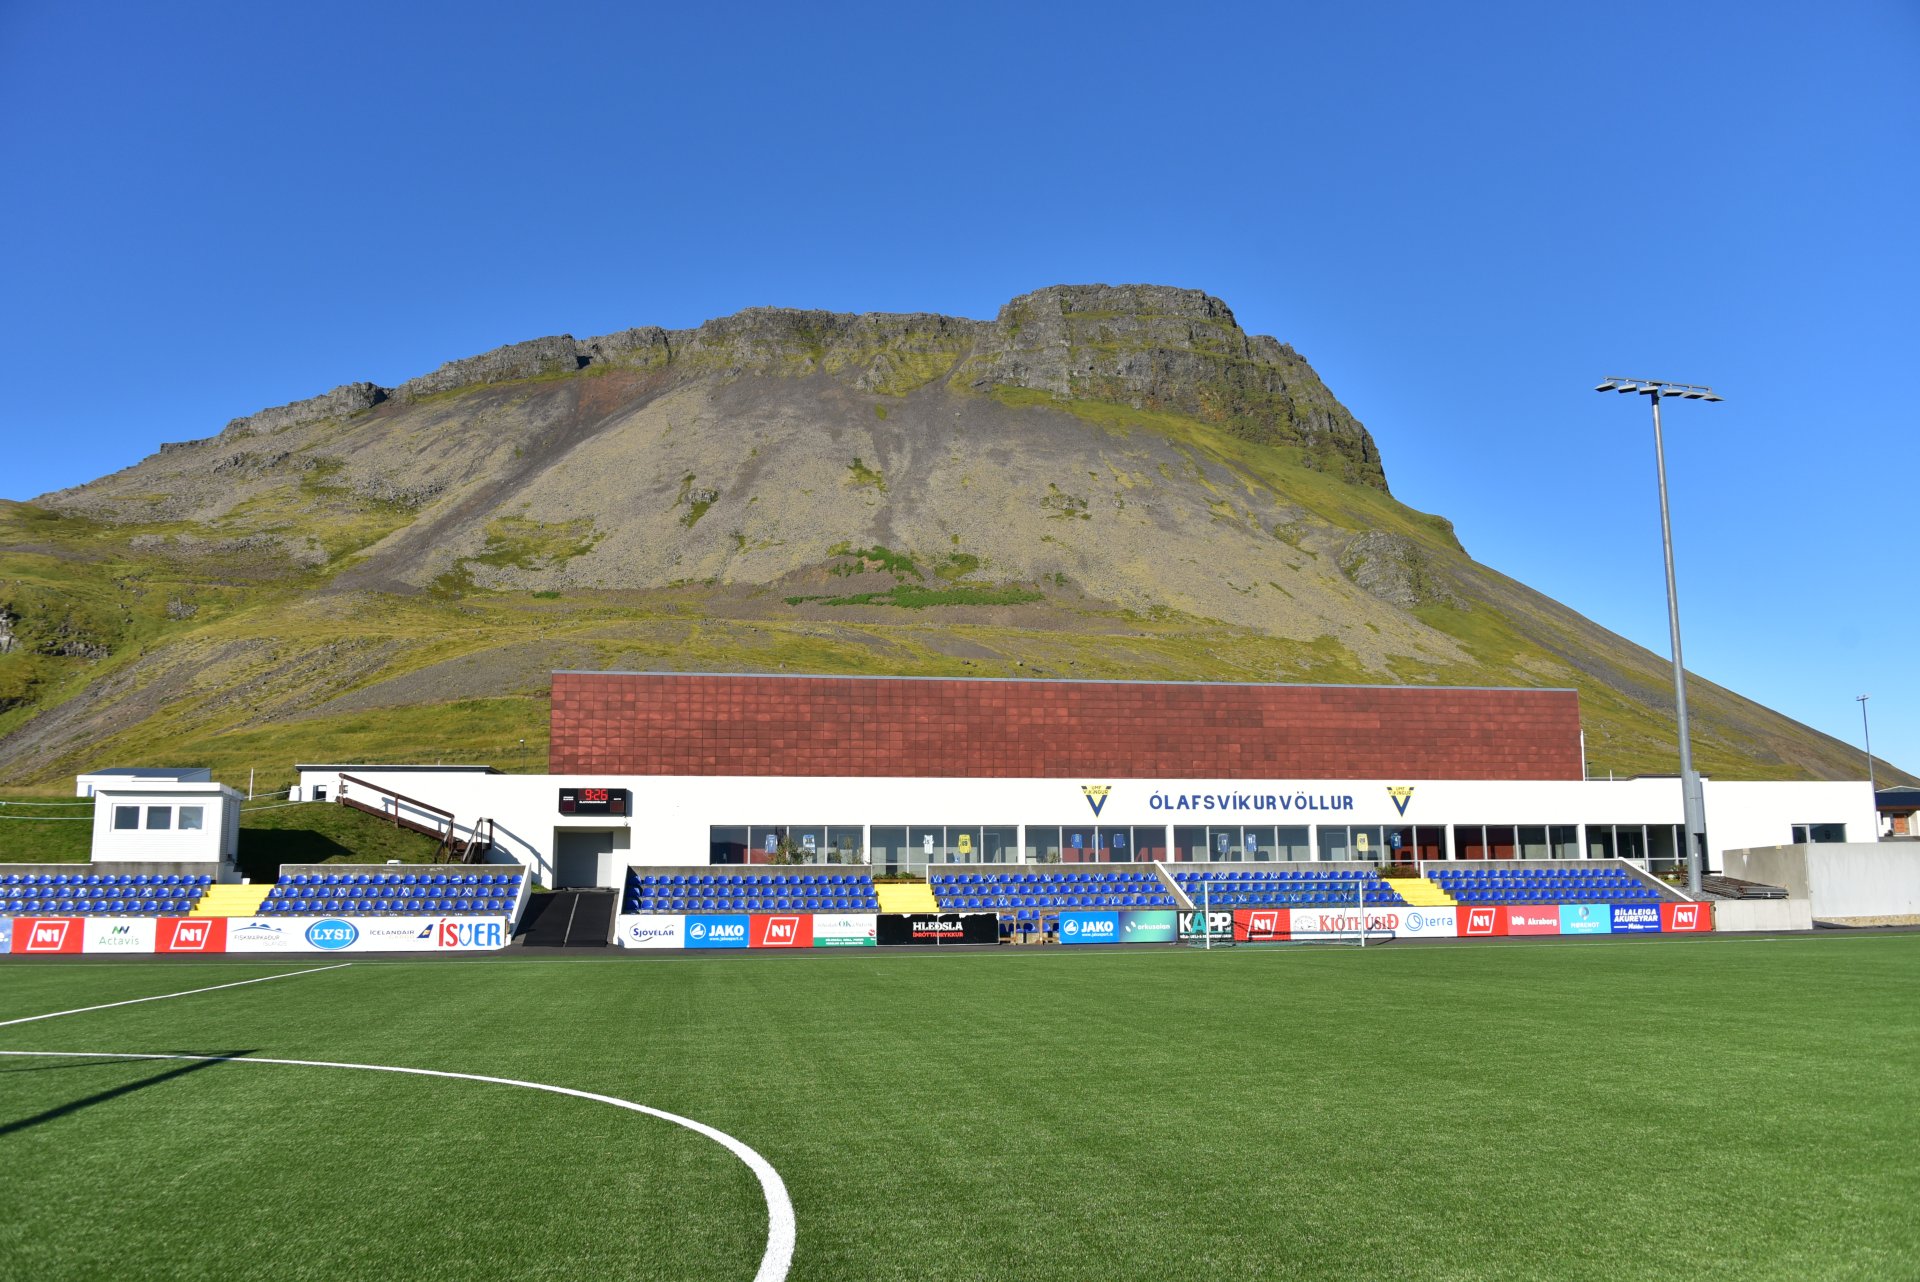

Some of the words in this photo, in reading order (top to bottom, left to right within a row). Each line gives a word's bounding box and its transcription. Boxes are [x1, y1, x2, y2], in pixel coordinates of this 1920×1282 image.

[585, 788, 608, 801] 9:26
[1149, 790, 1354, 810] ÓLAFSVÍKURVÖLLUR
[1614, 907, 1657, 916] BÍLALEIGA
[1677, 911, 1694, 923] N1
[1179, 912, 1232, 933] KAPP
[1253, 918, 1271, 931] N1
[1425, 916, 1453, 927] terra
[1473, 915, 1490, 927] N1
[1614, 915, 1659, 923] AKUREYRAR
[708, 925, 744, 937] JAKO
[771, 924, 791, 937] N1
[1081, 921, 1114, 933] JAKO
[37, 928, 59, 942] N1
[99, 935, 140, 946] Actavis
[180, 928, 202, 942] N1
